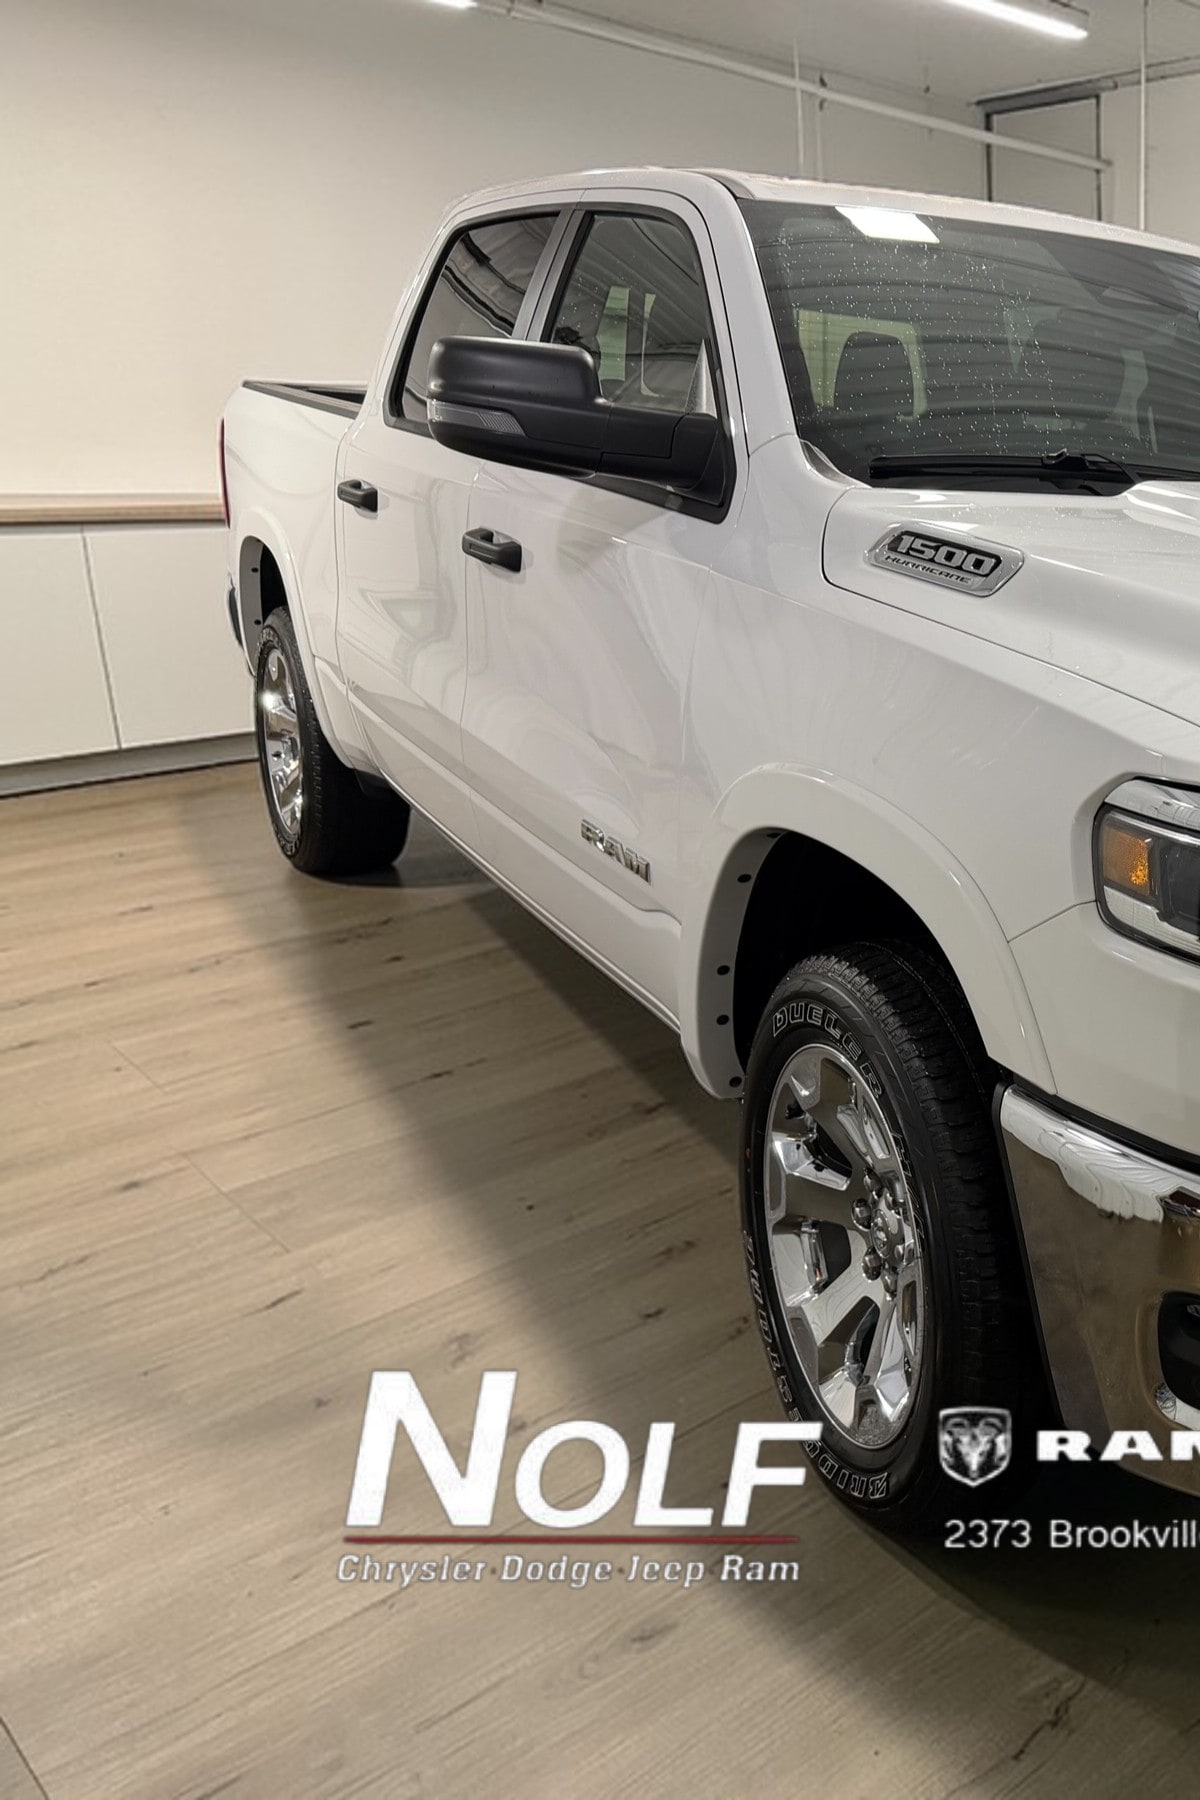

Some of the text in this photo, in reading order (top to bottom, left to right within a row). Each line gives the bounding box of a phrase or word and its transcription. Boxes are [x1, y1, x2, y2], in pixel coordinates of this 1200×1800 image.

[884, 554, 972, 584] HURRICANE
[897, 535, 996, 576] 1500
[772, 1002, 882, 1099] DUELER
